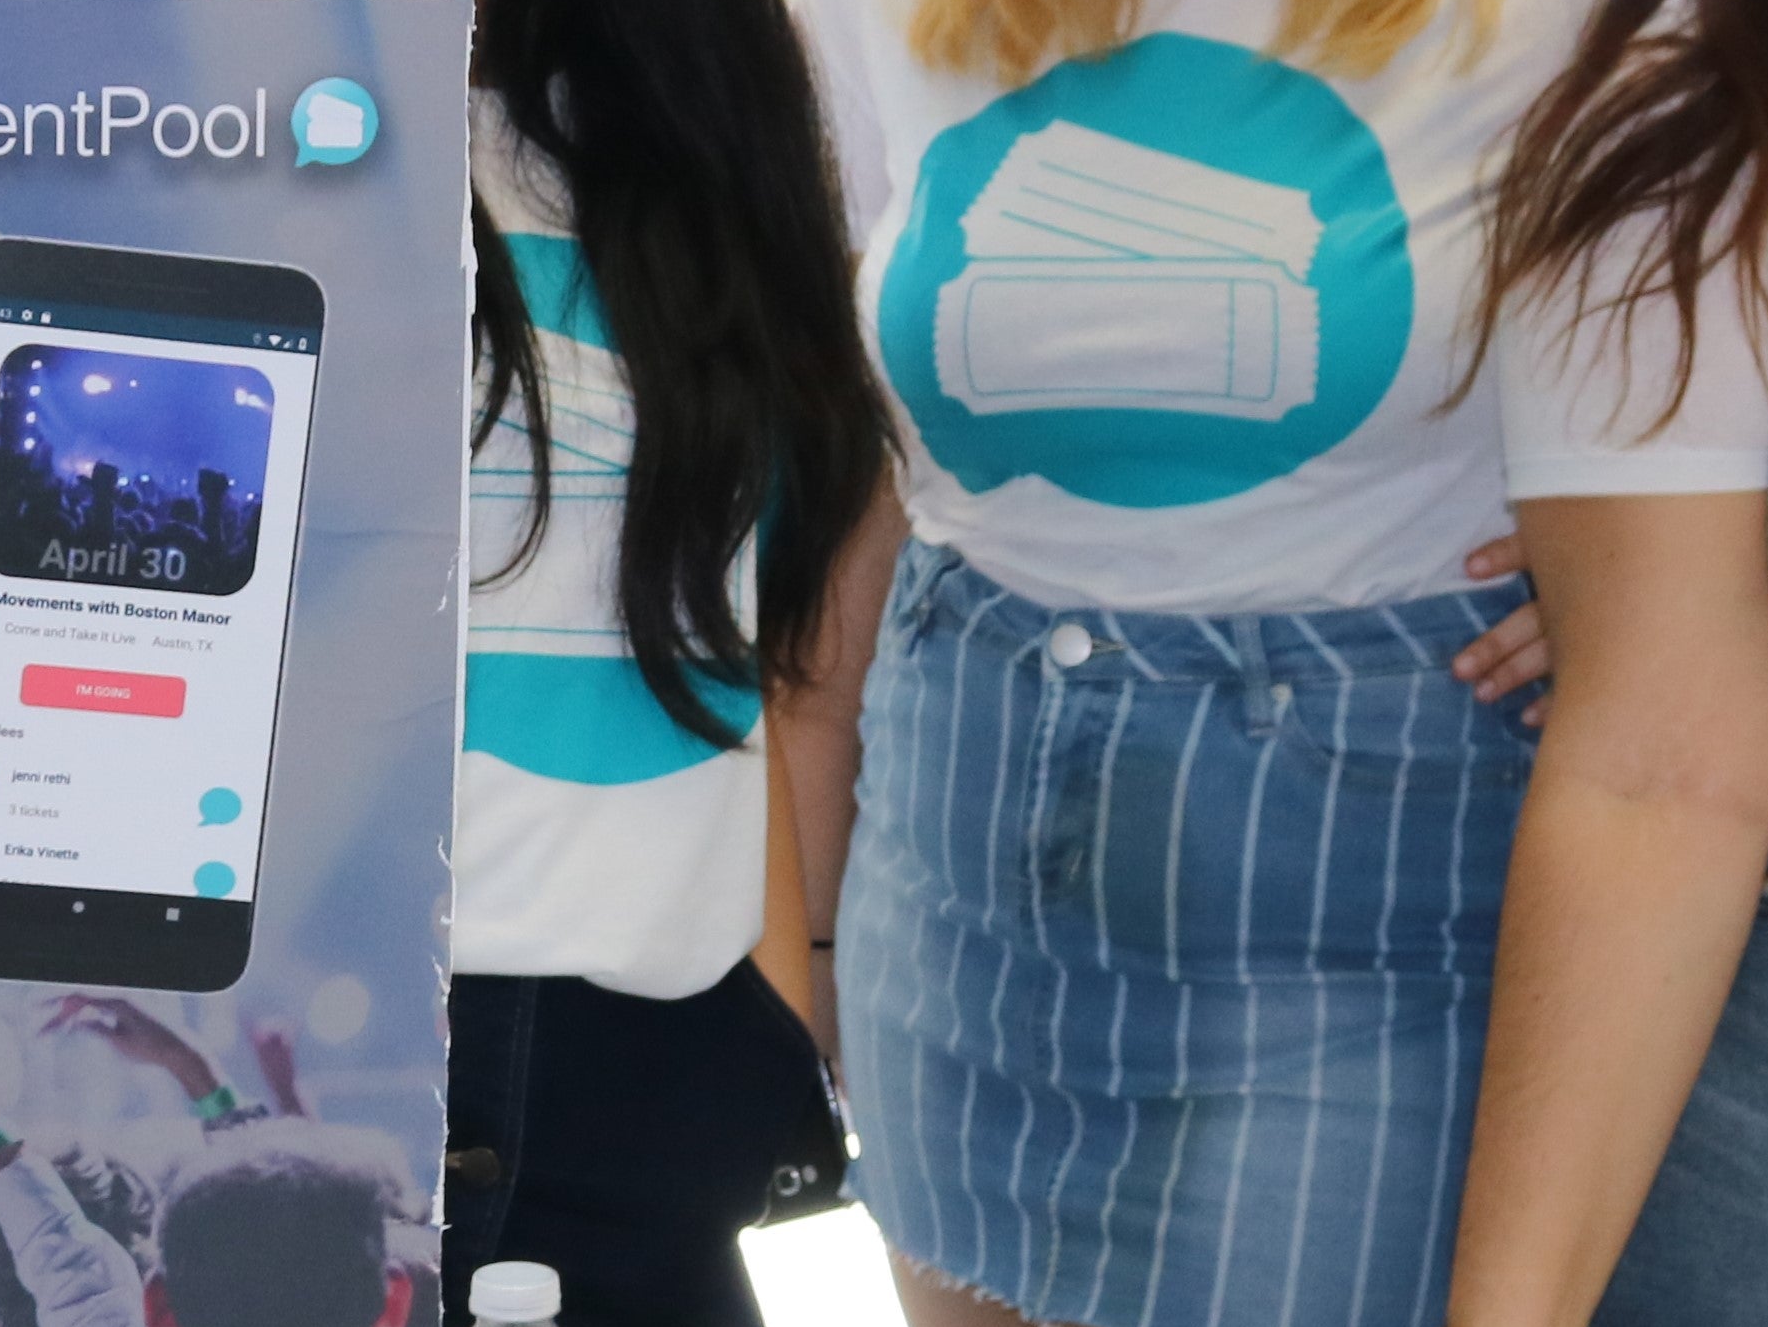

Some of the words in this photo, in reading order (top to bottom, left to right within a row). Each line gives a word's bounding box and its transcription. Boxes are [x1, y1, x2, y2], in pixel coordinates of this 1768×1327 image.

[37, 537, 129, 582] April
[139, 546, 188, 582] 30
[87, 600, 120, 615] with
[124, 603, 178, 621] Boston
[181, 608, 232, 625] Manor
[4, 622, 40, 635] Come
[42, 625, 66, 638] and
[70, 629, 98, 641] Take
[112, 633, 136, 645] Live
[152, 635, 194, 653] Austin,
[197, 640, 214, 652] TX
[11, 770, 41, 784] jenni
[43, 772, 71, 785] rethi
[19, 805, 60, 819] tickets
[4, 844, 34, 858] Erika
[38, 847, 80, 862] Vinette
